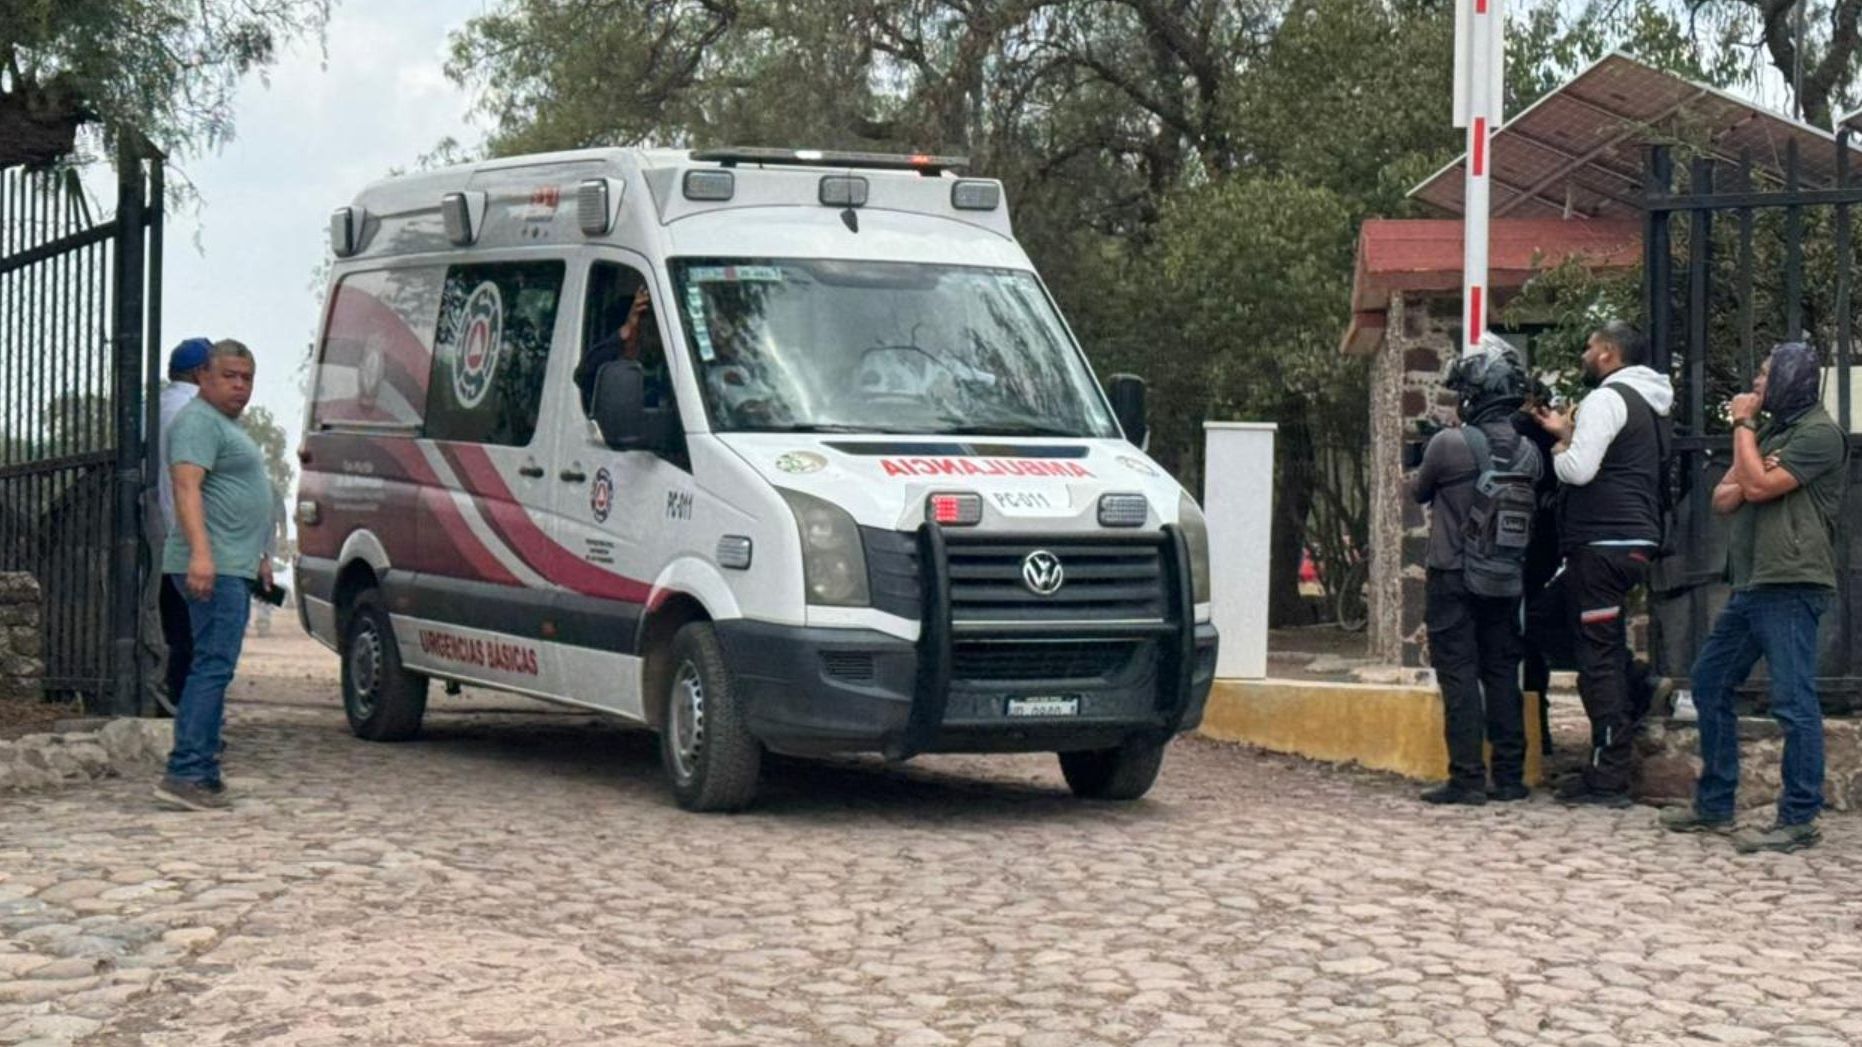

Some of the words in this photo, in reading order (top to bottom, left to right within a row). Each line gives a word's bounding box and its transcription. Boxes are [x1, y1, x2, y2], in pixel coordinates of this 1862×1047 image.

[666, 490, 694, 520] PC-011
[993, 491, 1051, 509] PC-011
[419, 628, 485, 667] URGENCIAS
